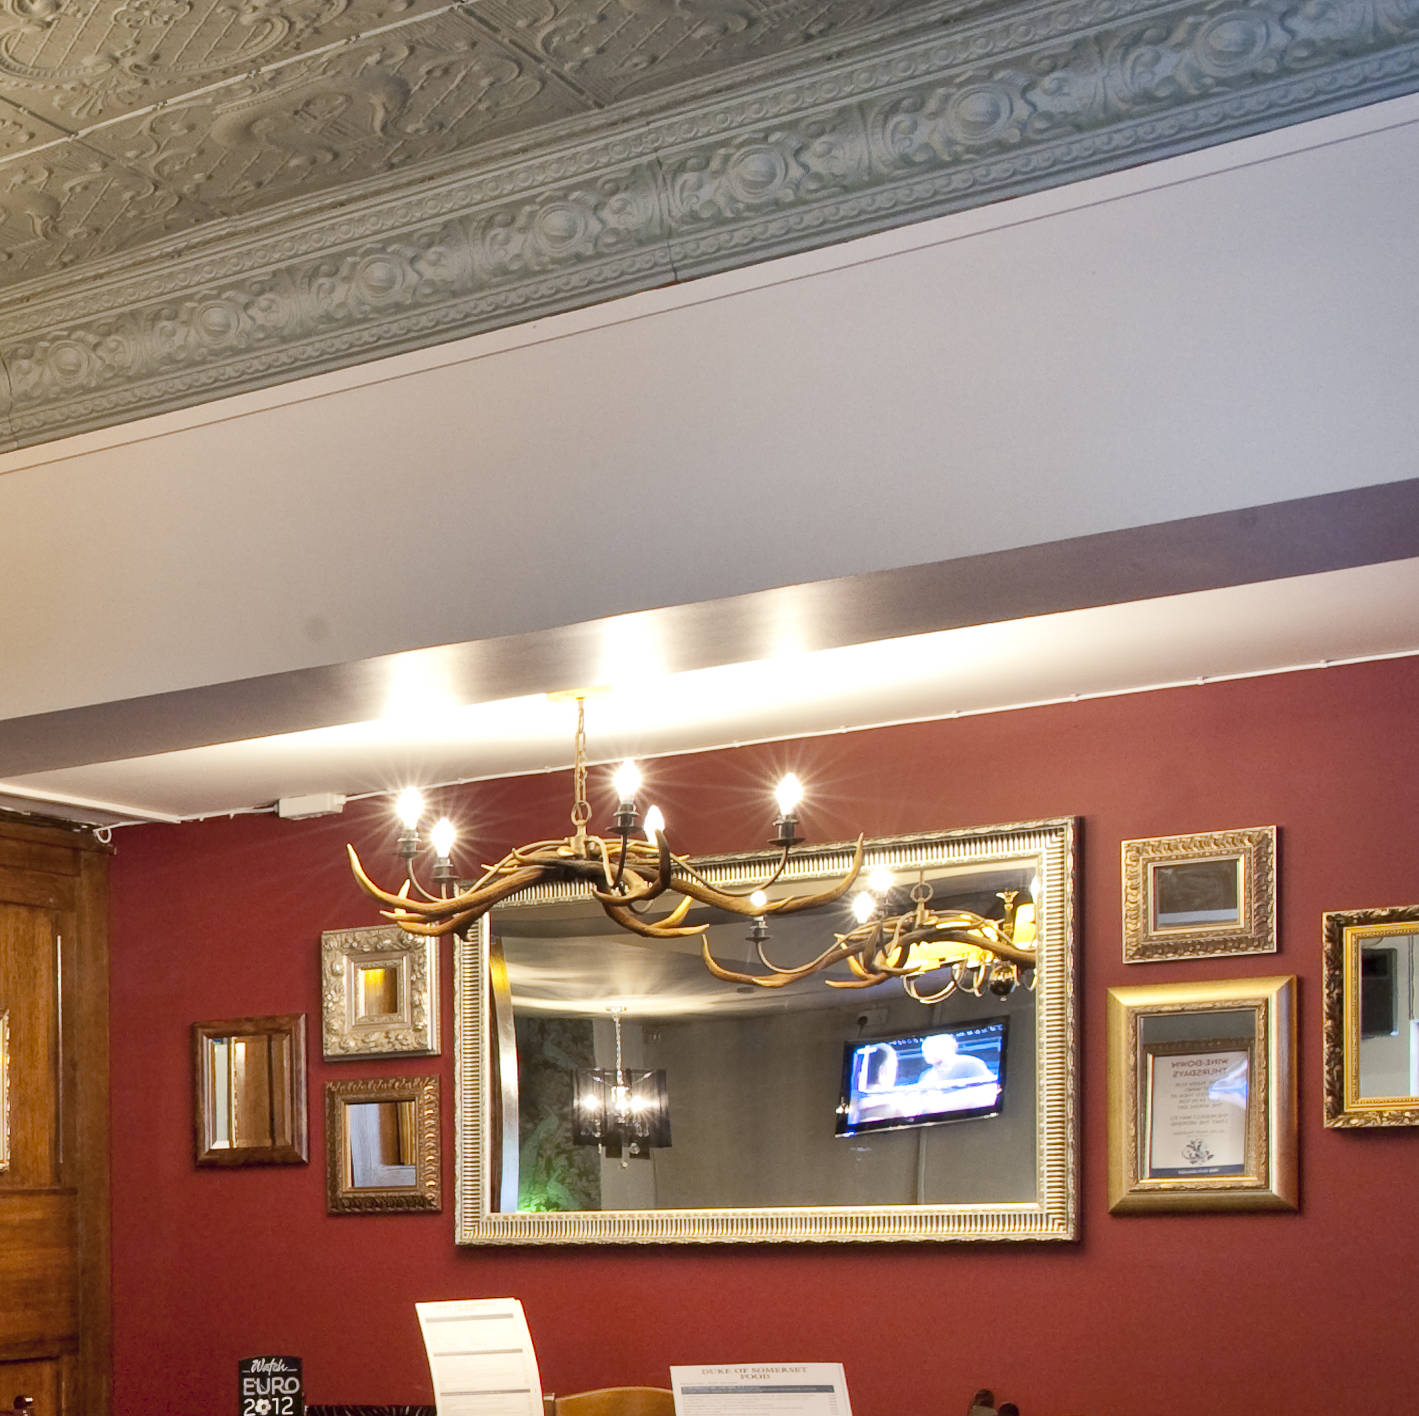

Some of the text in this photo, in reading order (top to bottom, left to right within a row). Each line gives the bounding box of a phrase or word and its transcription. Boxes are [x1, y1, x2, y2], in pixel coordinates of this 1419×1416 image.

[251, 1357, 289, 1376] Watch
[751, 1366, 809, 1374] SOMERSET
[243, 1376, 300, 1396] EURO
